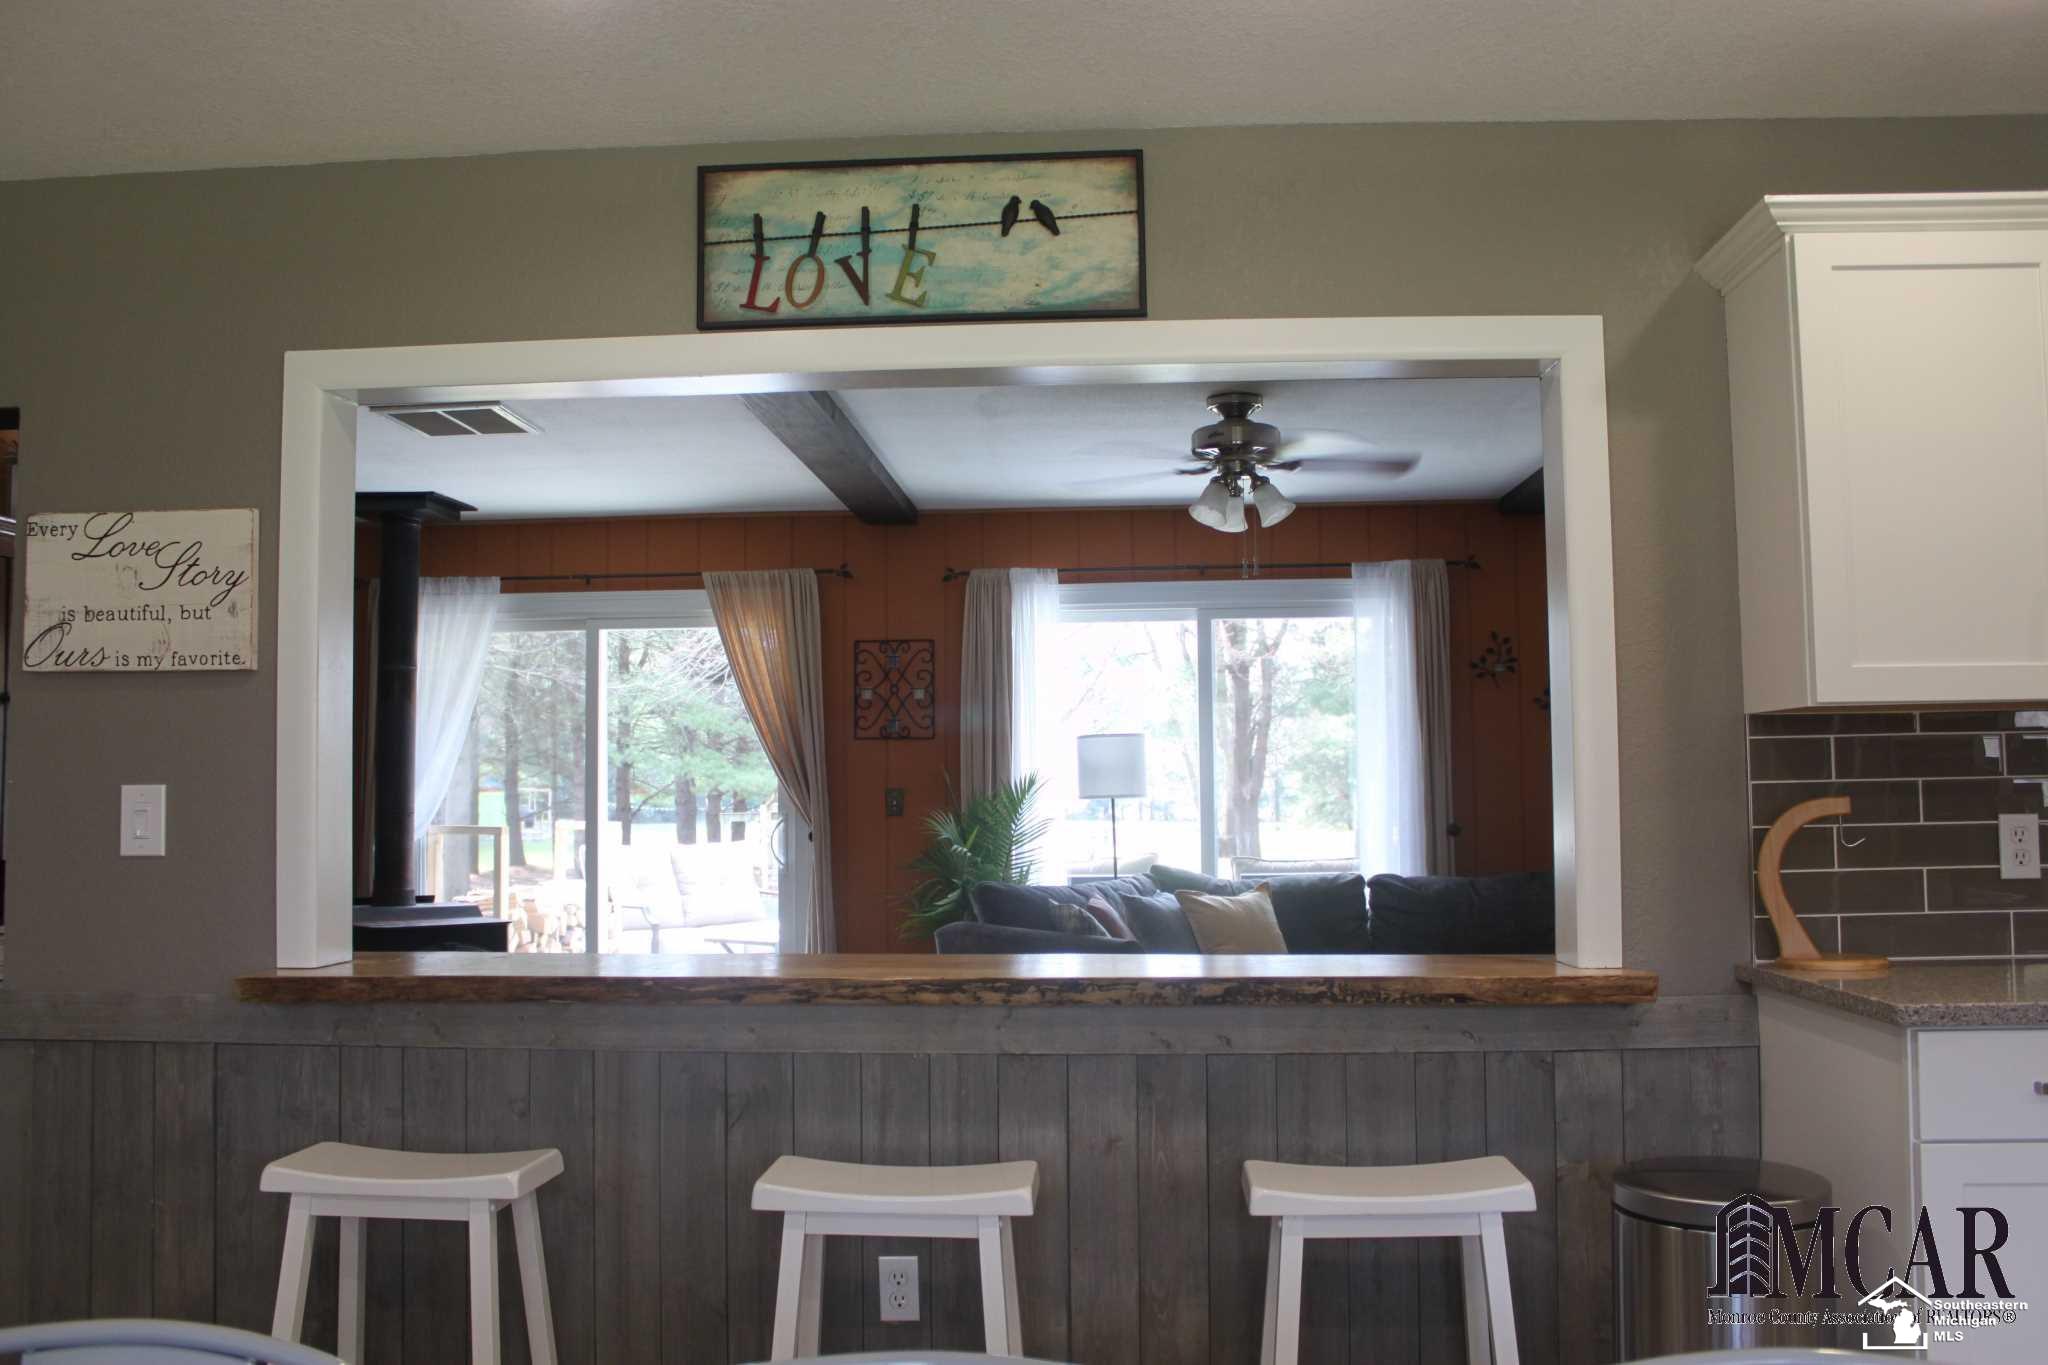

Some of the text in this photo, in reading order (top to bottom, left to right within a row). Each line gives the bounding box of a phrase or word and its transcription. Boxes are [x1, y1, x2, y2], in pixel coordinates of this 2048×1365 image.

[739, 248, 936, 313] LOVE
[27, 512, 249, 607] Every Love Story
[59, 605, 212, 624] is beautiful, but
[24, 622, 246, 671] Ours is my favorite.
